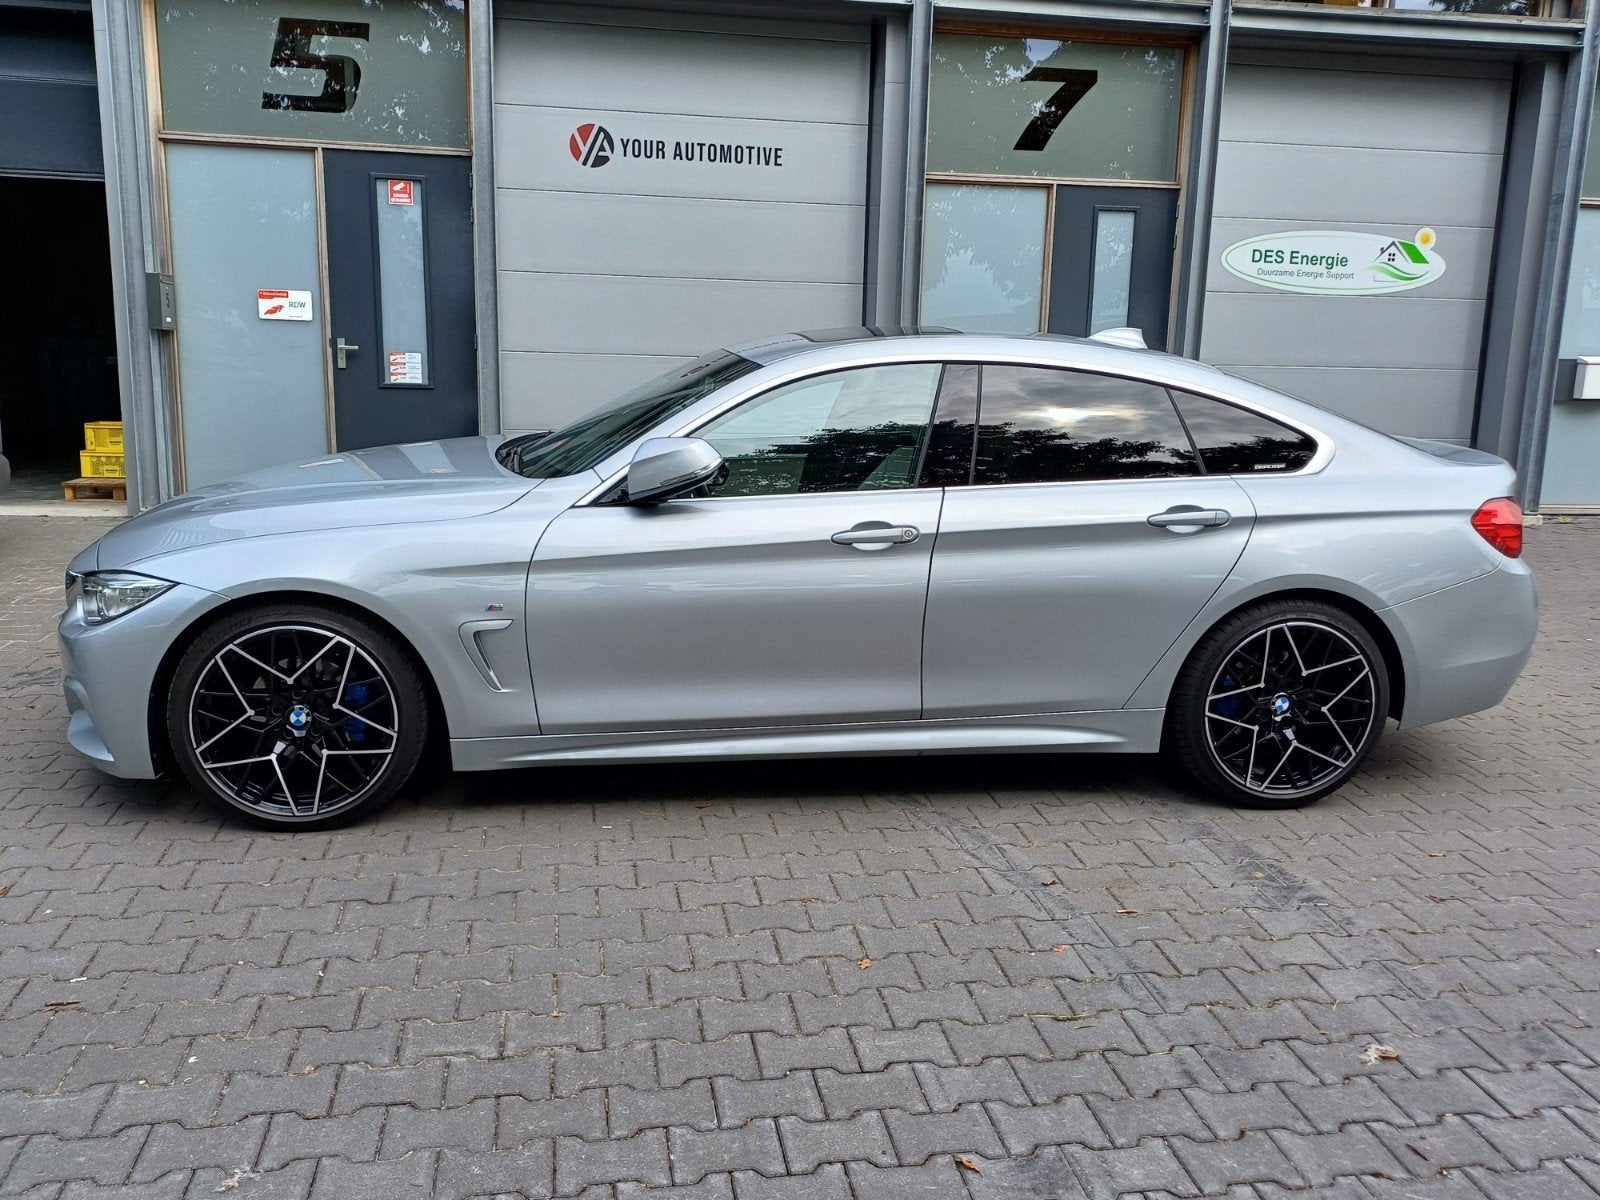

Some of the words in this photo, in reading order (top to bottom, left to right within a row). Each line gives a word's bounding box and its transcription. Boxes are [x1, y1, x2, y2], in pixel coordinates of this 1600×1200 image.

[262, 17, 370, 113] 5
[1013, 67, 1098, 151] 7
[620, 138, 666, 160] YOUR
[673, 141, 783, 167] AUTOMOTIVE
[1252, 249, 1285, 264] DES
[1289, 250, 1348, 270] Energie
[1257, 268, 1295, 277] Duurzame
[1296, 269, 1324, 280] Energie
[1326, 271, 1354, 280] Support
